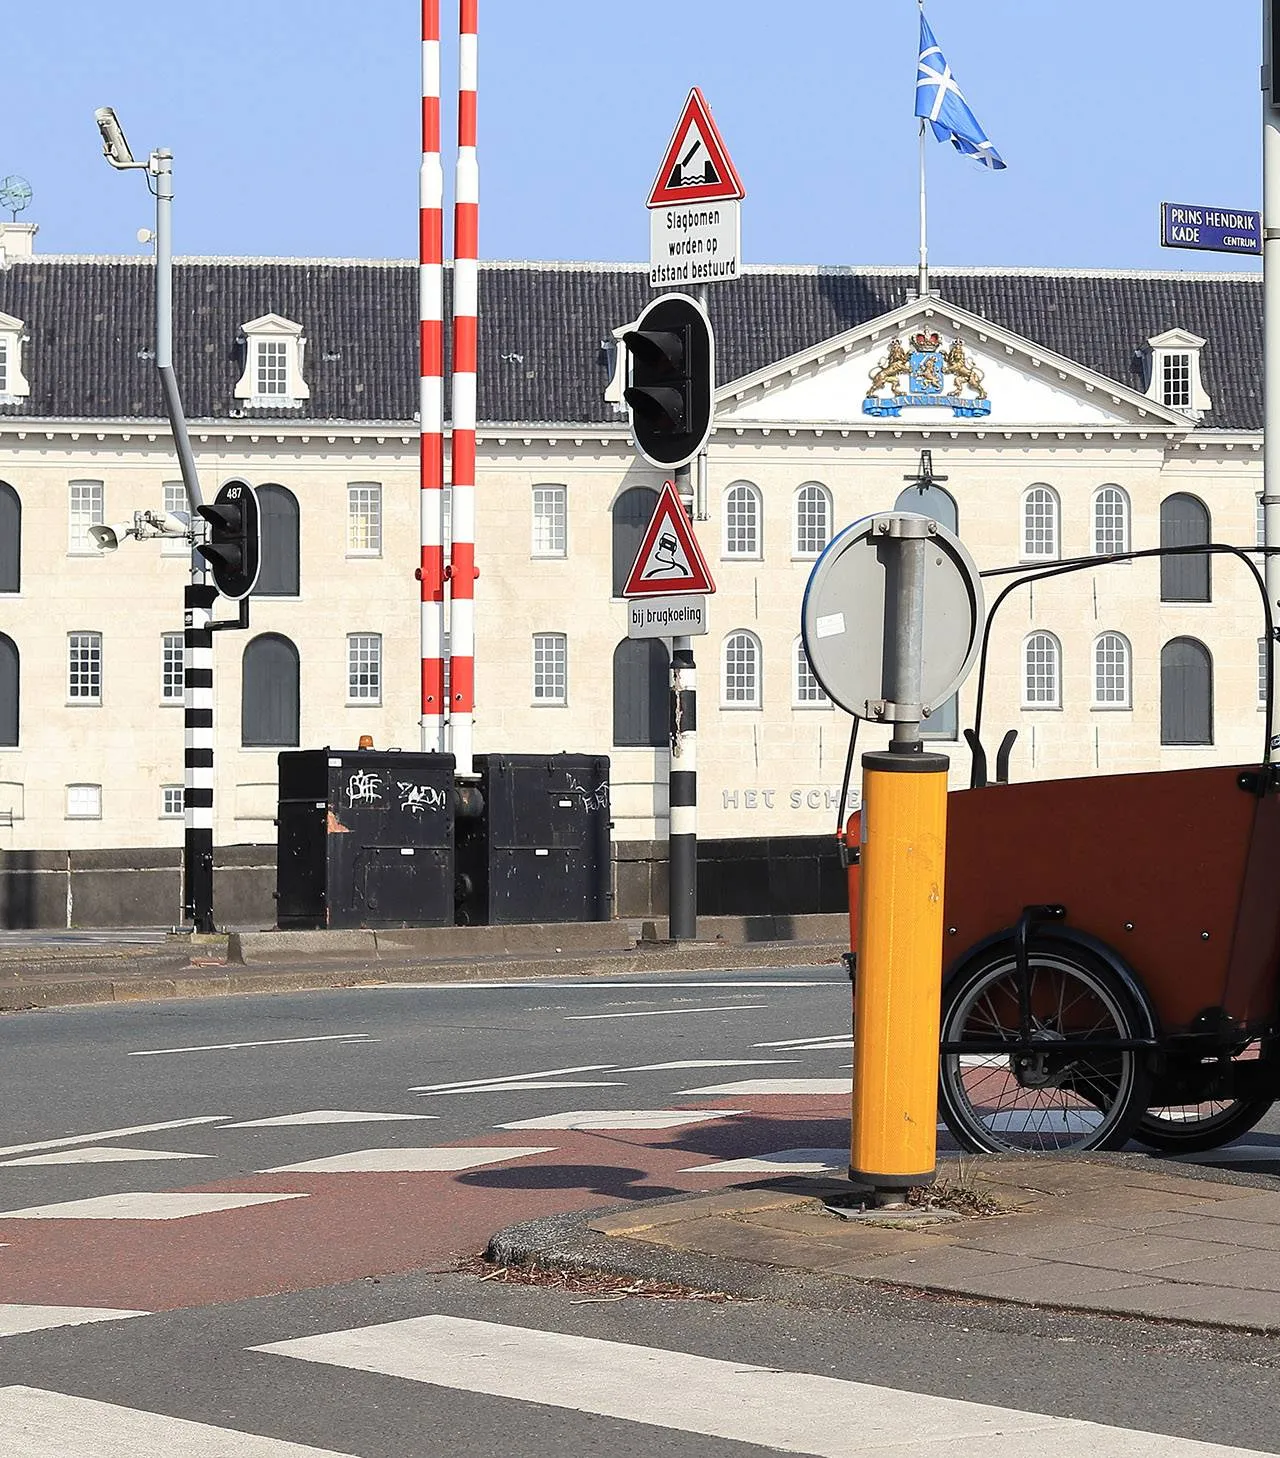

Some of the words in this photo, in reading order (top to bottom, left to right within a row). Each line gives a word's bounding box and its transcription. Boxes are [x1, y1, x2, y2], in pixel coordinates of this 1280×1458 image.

[666, 210, 720, 233] Slagbomen
[1171, 208, 1202, 225] PRINS
[1205, 211, 1255, 231] HENDRIK
[1171, 226, 1200, 243] KADE
[1223, 236, 1257, 248] CENTRUM
[668, 236, 703, 256] worden
[706, 237, 718, 256] op
[651, 261, 688, 283] afstand
[691, 256, 736, 279] bestuurd
[226, 487, 242, 500] 487
[632, 609, 644, 628] bij
[646, 606, 701, 626] brugkoeling
[722, 789, 775, 809] HET
